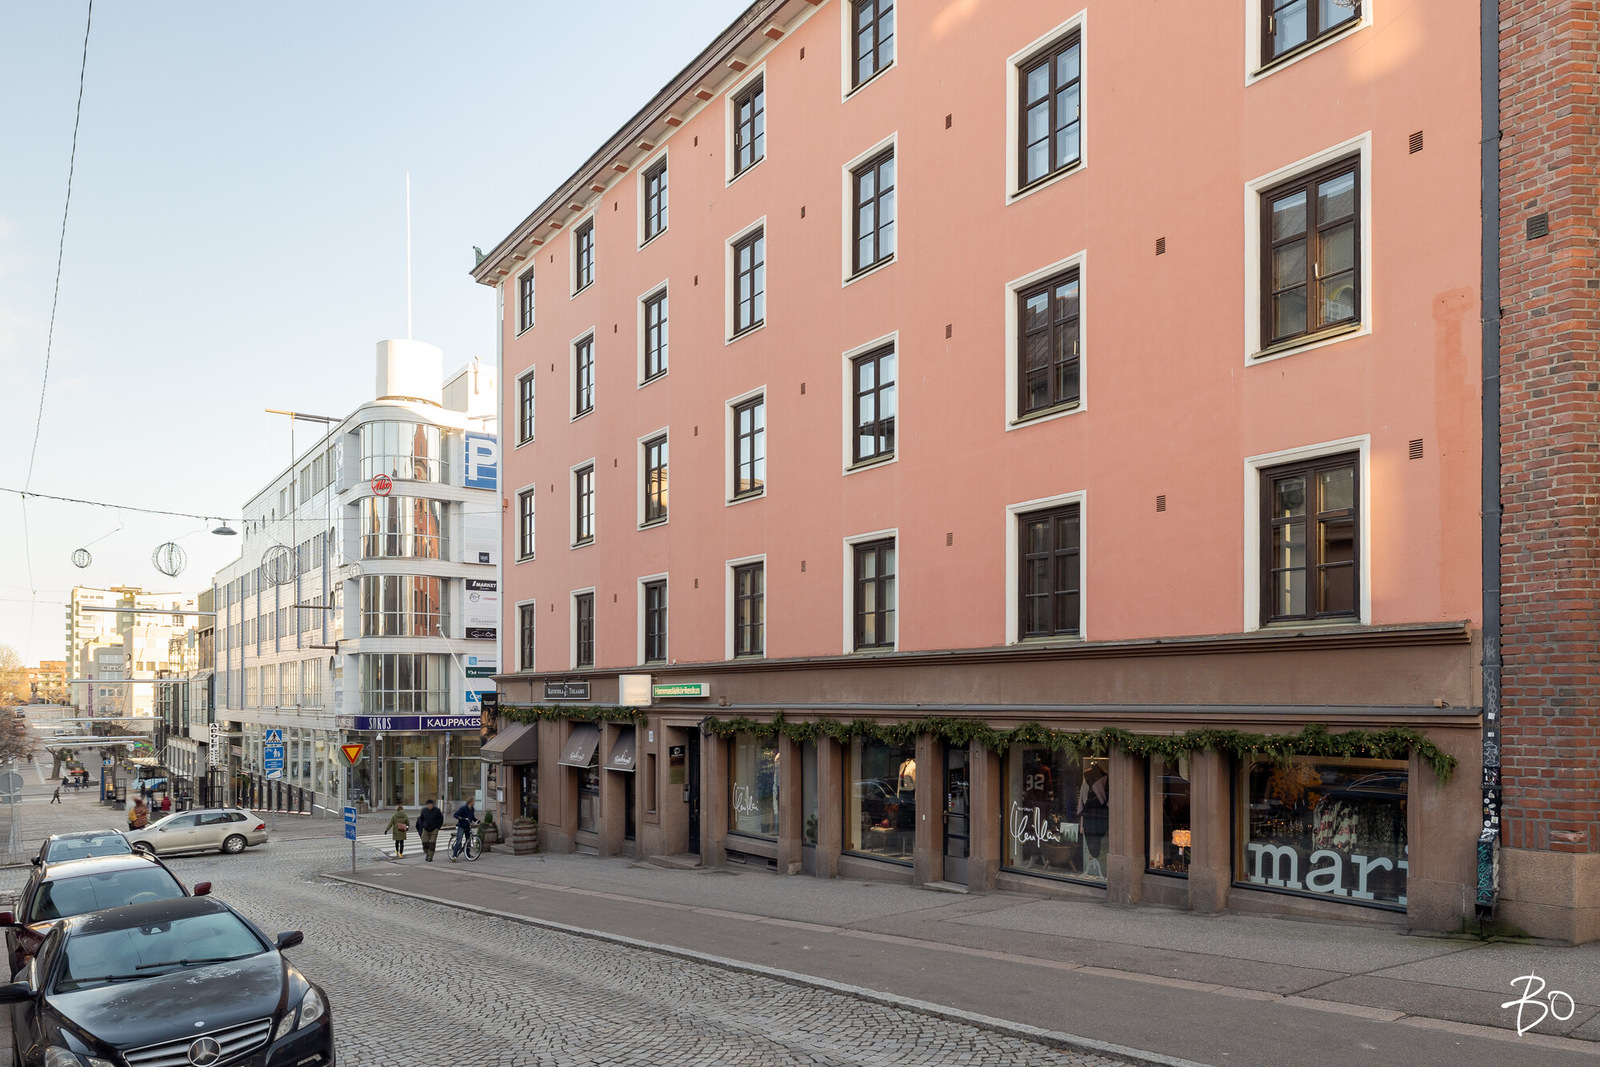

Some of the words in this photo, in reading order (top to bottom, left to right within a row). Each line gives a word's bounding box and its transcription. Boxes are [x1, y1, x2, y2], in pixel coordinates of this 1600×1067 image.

[468, 438, 497, 480] P
[373, 479, 392, 491] Alko
[368, 717, 392, 730] SOKOS
